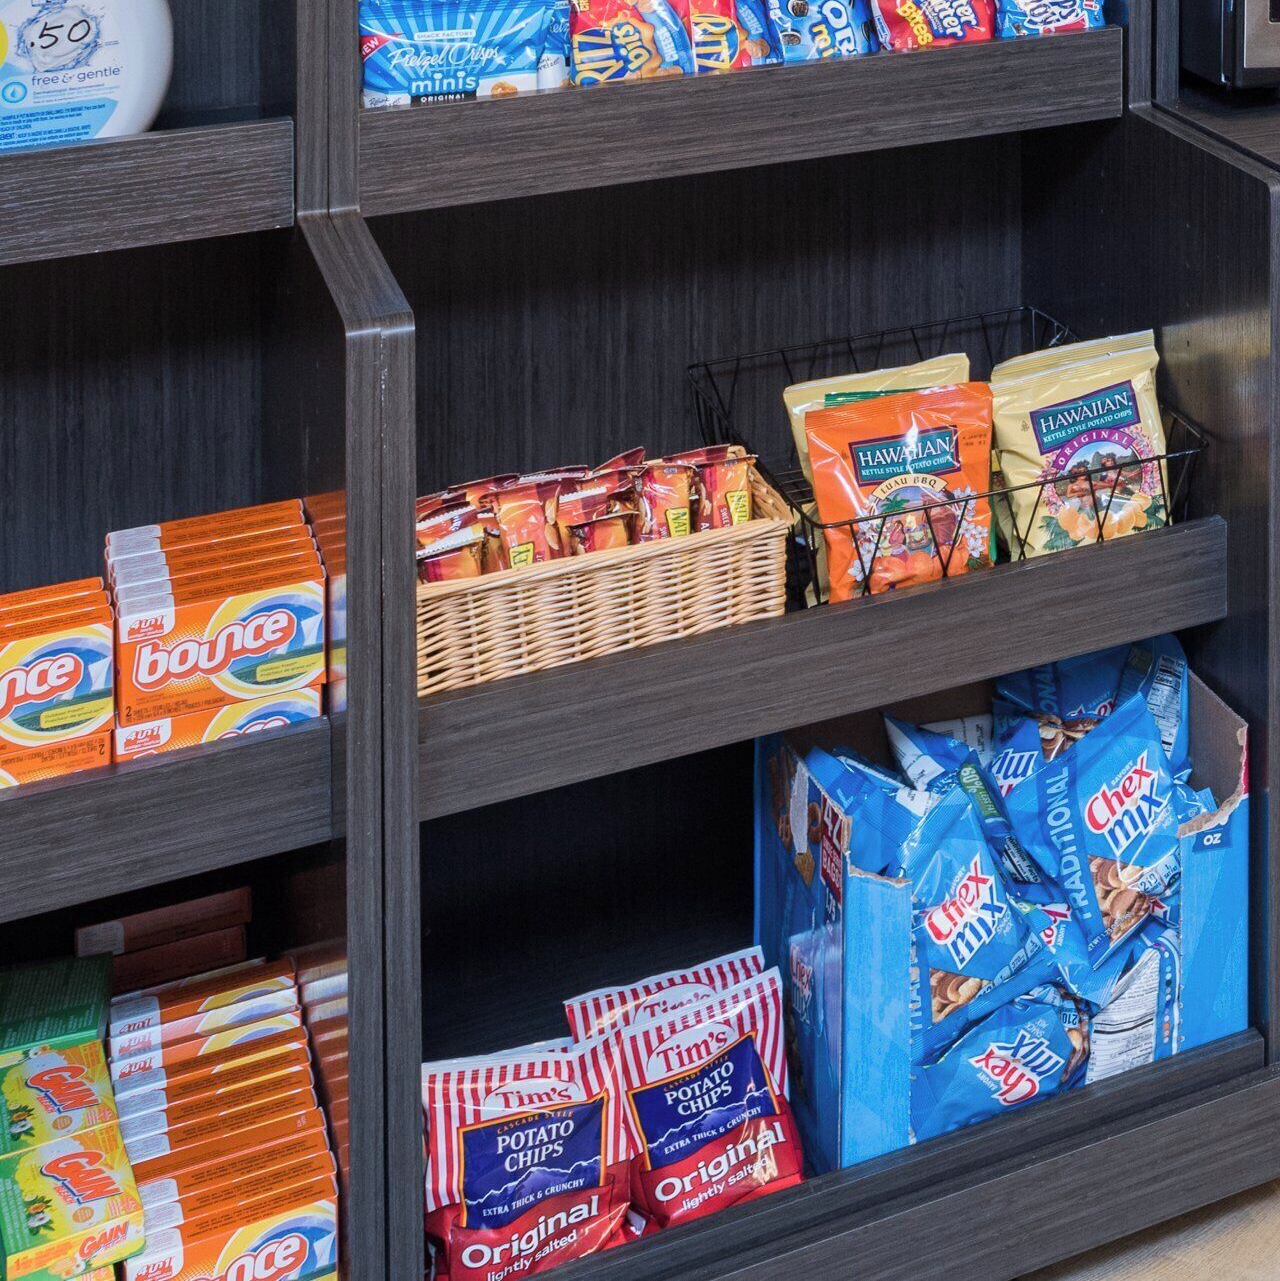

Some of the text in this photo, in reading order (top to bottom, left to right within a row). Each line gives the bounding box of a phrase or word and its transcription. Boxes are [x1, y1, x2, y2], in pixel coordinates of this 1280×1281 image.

[31, 67, 121, 86] free & gentle
[388, 41, 500, 71] Pretzel Crisps
[572, 29, 625, 85] RITZ
[410, 71, 478, 94] minis
[1040, 391, 1131, 433] HAWAIIAN
[858, 437, 951, 466] HAWAIIAN
[1058, 430, 1130, 466] ORIGINAL
[137, 612, 294, 688] bounce
[1084, 755, 1158, 836] Chex
[926, 866, 996, 945] Chex
[656, 1028, 728, 1075] Tim's
[495, 1087, 573, 1112] Tim's
[665, 1061, 735, 1106] POTATO
[677, 1079, 733, 1118] CHIPS
[496, 1119, 575, 1155] POTATO
[664, 1105, 762, 1155] EXTRA THICK & CRUNCHY
[504, 1140, 564, 1174] CHIPS
[655, 1120, 786, 1204] Original
[682, 1157, 769, 1212] lightly salted
[79, 1222, 130, 1259] GAIN
[461, 1194, 600, 1270] Original
